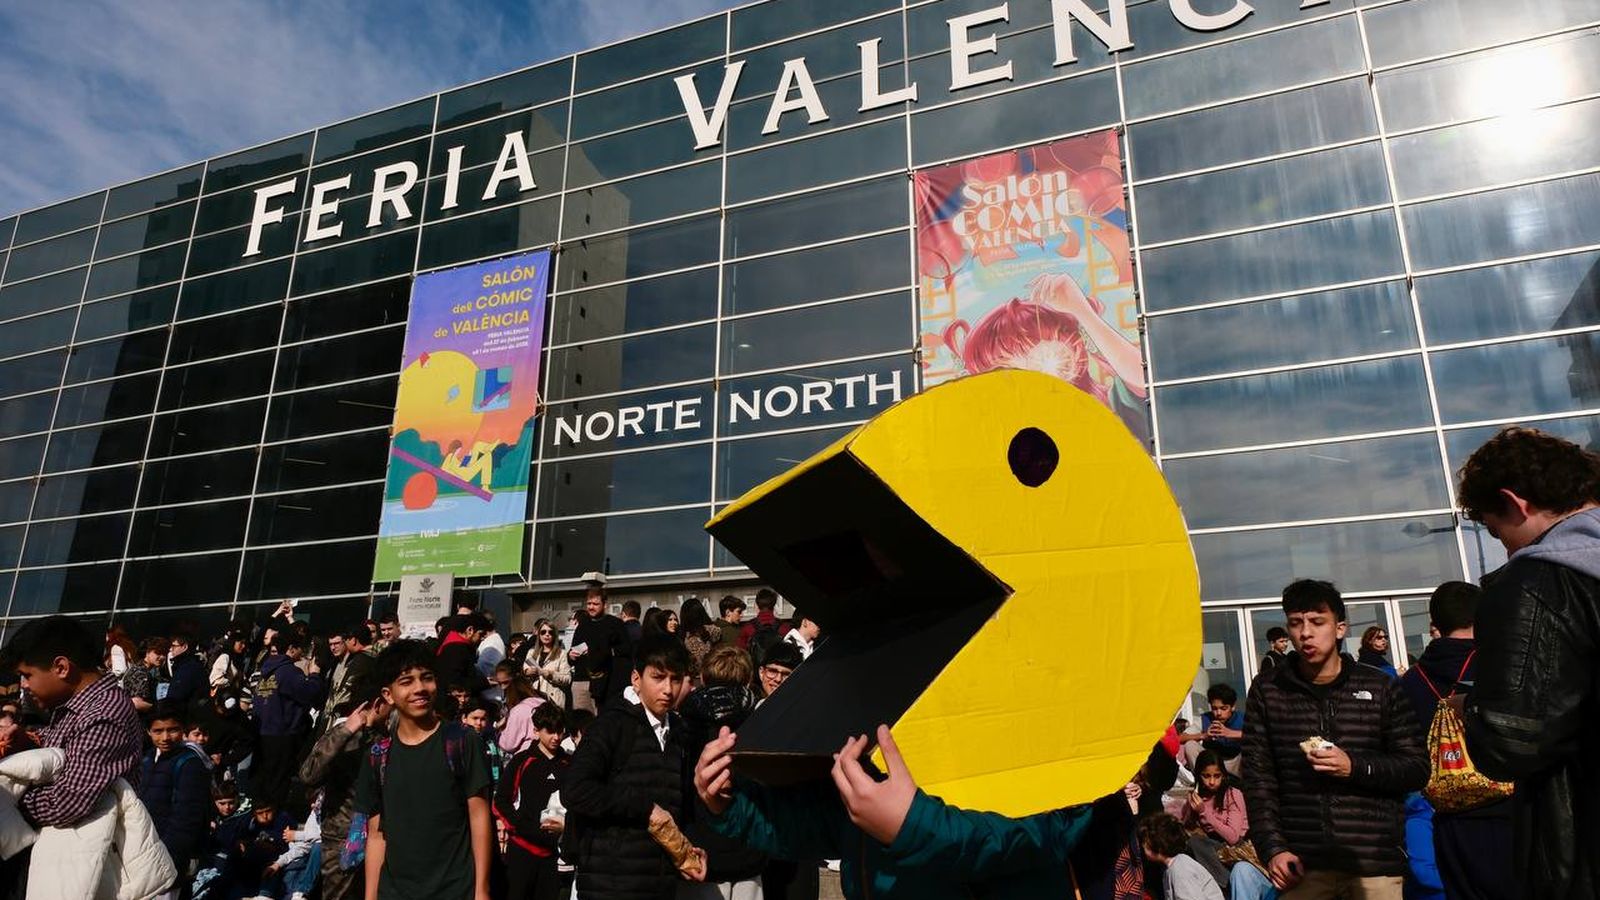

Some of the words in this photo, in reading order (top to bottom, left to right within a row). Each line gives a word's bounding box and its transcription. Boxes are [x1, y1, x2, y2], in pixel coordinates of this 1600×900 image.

[242, 130, 537, 258] FERIA
[673, 0, 1331, 150] VALEN
[482, 264, 536, 288] SALÓN
[452, 302, 473, 315] del
[475, 287, 533, 310] CÓMIC
[433, 327, 449, 339] de
[553, 397, 702, 446] NORTE
[729, 370, 901, 424] NORTH
